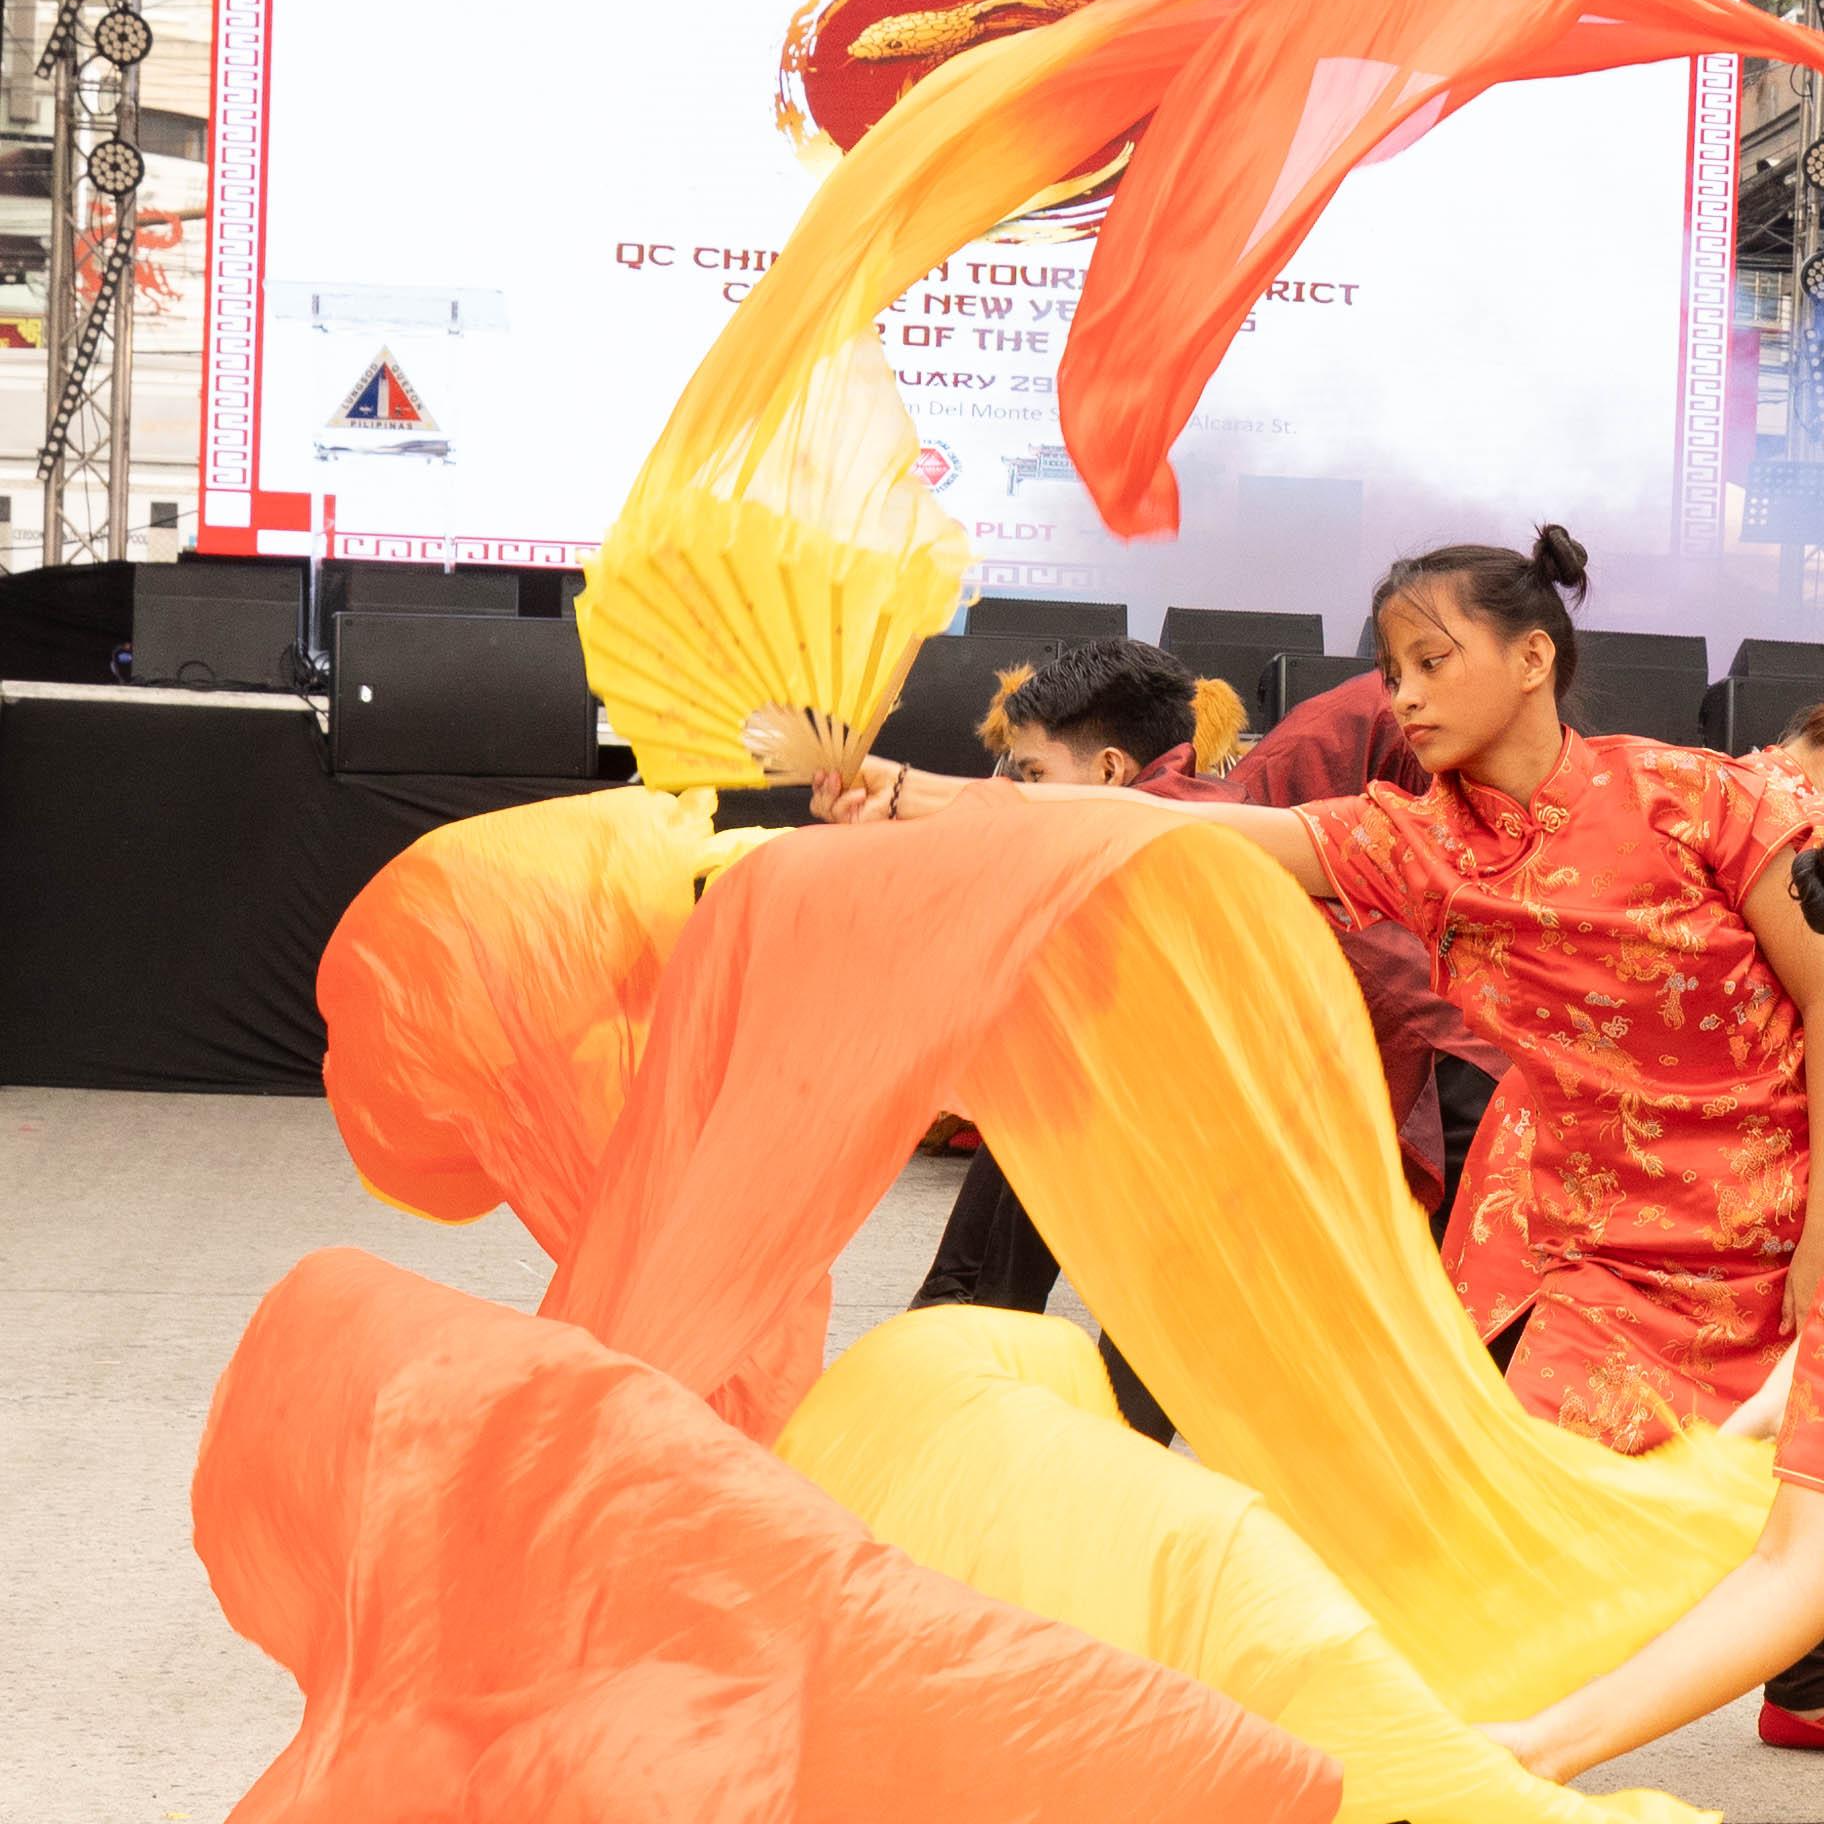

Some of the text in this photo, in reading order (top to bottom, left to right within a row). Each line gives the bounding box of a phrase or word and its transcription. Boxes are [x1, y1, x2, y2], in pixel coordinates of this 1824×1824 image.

[616, 242, 676, 269] QC
[923, 292, 1014, 321] NEW
[903, 325, 955, 349] OF
[973, 327, 1049, 354] THE
[342, 363, 378, 410] LUNGSOD
[391, 364, 423, 411] QUEZON
[350, 420, 414, 431] PILIPINAS
[928, 399, 964, 417] Del
[971, 402, 1043, 422] Monte
[1271, 417, 1298, 435] St.
[975, 522, 1057, 541] PLDT
